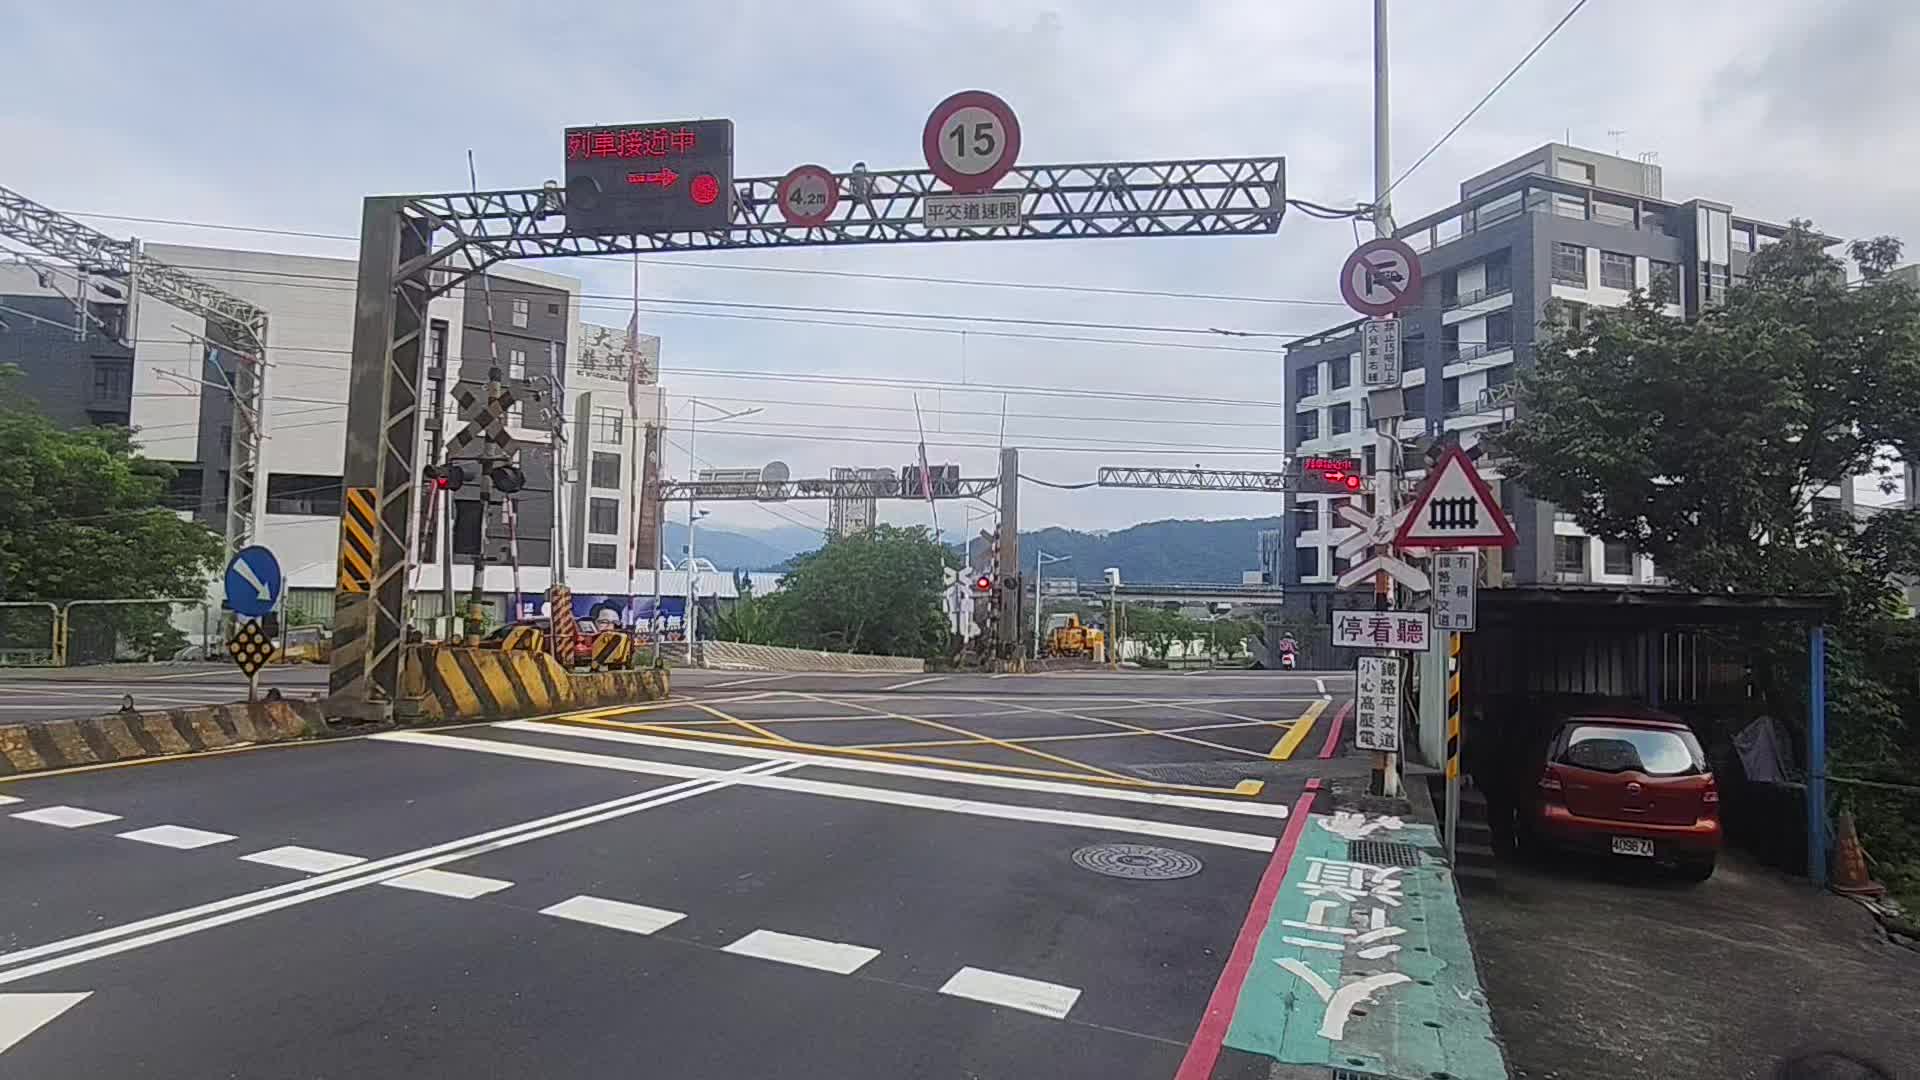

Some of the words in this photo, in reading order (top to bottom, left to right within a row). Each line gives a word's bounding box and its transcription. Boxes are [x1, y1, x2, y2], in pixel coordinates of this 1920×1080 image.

[567, 127, 696, 160] 列車接近中
[949, 123, 995, 157] 15
[927, 202, 1017, 222] 平交道速限
[1337, 615, 1424, 645] 停看聽
[1360, 659, 1377, 748] 小心高壓電
[1379, 660, 1397, 749] 鐵路平交道
